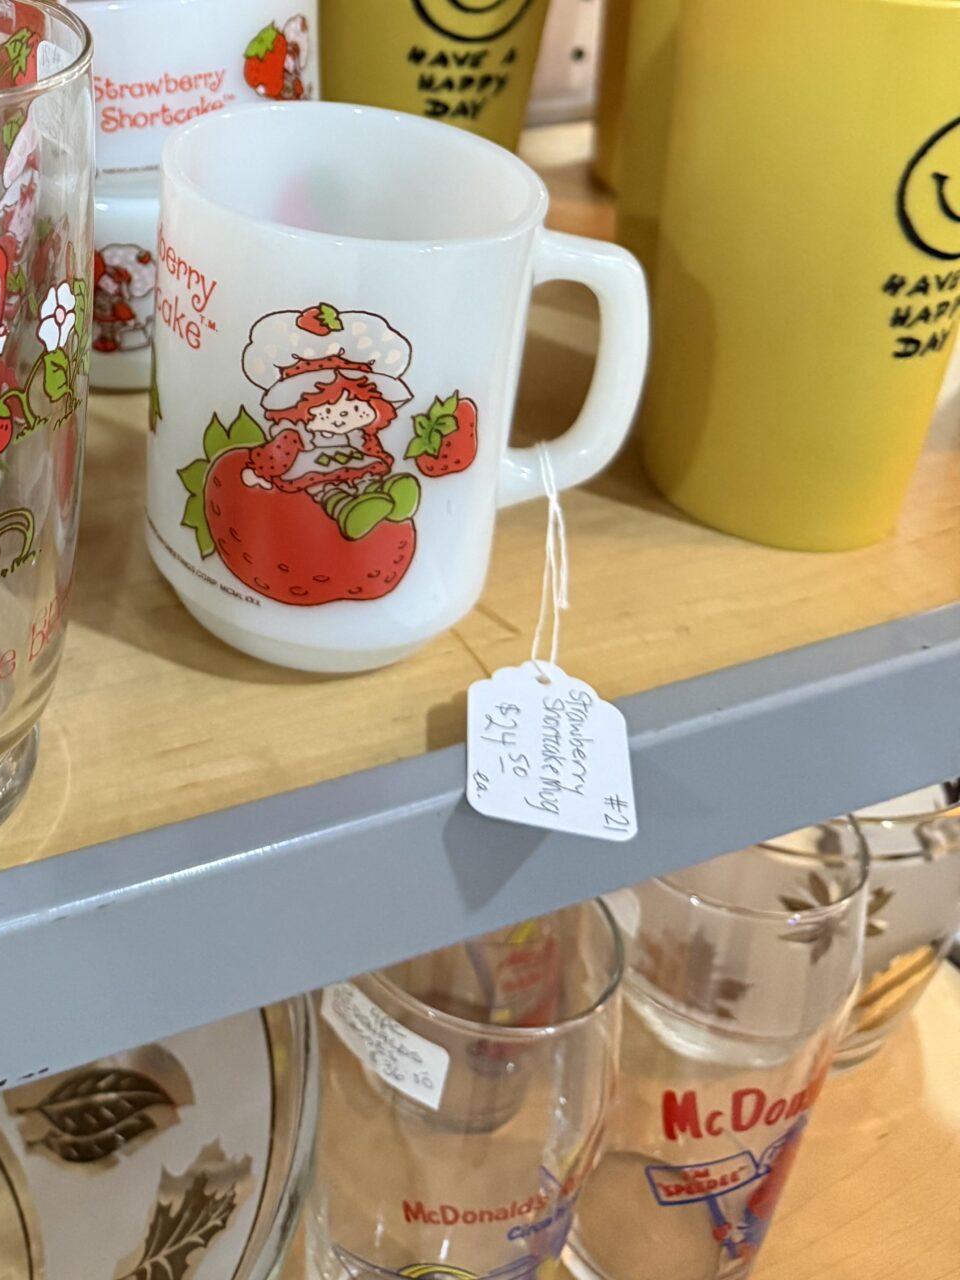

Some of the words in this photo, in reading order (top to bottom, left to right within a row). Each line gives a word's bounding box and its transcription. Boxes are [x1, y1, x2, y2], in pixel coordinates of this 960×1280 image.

[406, 45, 489, 69] HAVE
[94, 69, 226, 104] Strawberry
[417, 73, 509, 96] HAPPY
[424, 98, 486, 120] DAY
[892, 329, 948, 359] DAY
[564, 688, 595, 796] Strawberry
[604, 794, 630, 833] #21
